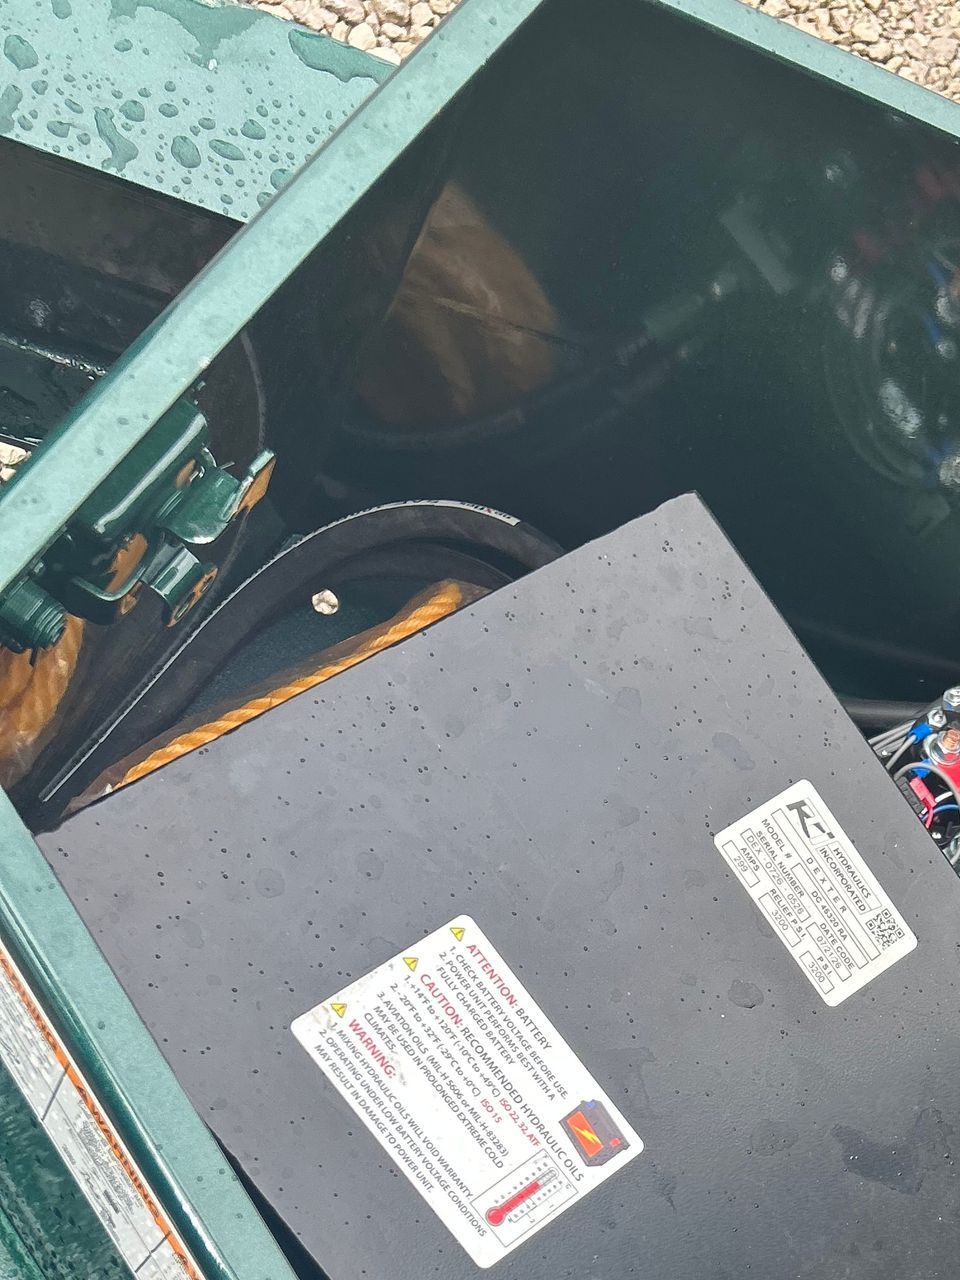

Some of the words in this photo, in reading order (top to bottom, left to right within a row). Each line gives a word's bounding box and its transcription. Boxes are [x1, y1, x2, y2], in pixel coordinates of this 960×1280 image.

[740, 846, 760, 871] AMPS
[746, 835, 763, 855] DEX
[755, 830, 779, 861] SERIAL
[776, 861, 804, 898] NUMBER
[760, 818, 786, 851] MODEL
[832, 847, 871, 899] HYDRAULICS
[769, 888, 792, 917] RELIEF
[770, 908, 789, 931] 3200
[818, 847, 866, 912] INCORPORATED
[807, 961, 825, 983] 3200
[819, 922, 837, 945] DATE
[835, 945, 854, 970] CODE
[836, 927, 848, 941] RA
[435, 966, 459, 992] FULLY
[454, 991, 489, 1032] CHARGED
[484, 1030, 515, 1066] BATTERY
[444, 959, 471, 990] POWER
[467, 989, 487, 1011] UNIT
[482, 1009, 520, 1053] PERFORMS
[515, 1051, 535, 1073] BEST
[530, 1070, 551, 1094] WITH
[547, 1092, 556, 1101] A
[454, 953, 479, 982] CHECK
[475, 980, 506, 1017] BATTERY
[501, 1014, 532, 1051] VOLTAGE
[528, 1050, 556, 1081] BEFORE
[551, 1080, 569, 1100] USE.
[464, 942, 520, 1008] ATTENTION:
[514, 1007, 552, 1051] BATTERY
[346, 1018, 398, 1079] WARNING:
[372, 1005, 391, 1025] MAY
[386, 1023, 399, 1035] BE
[395, 1034, 416, 1057] USED
[411, 1055, 423, 1066] IN
[418, 1064, 460, 1114] PROLONGED
[456, 1111, 487, 1148] EXTREME
[482, 1145, 504, 1169] COLD
[382, 998, 415, 1036] AVIATION
[410, 1034, 429, 1054] OILS
[445, 1079, 464, 1100] 5606
[460, 1098, 470, 1109] or
[412, 1011, 423, 1023] to
[454, 1066, 464, 1076] to
[479, 1098, 495, 1114] ISO
[490, 1112, 502, 1123] 15
[418, 972, 466, 1028] CAUTION:
[459, 1026, 524, 1105] RECOMMENDED
[519, 1103, 567, 1160] HYDRAULIC
[562, 1157, 584, 1182] OILS
[425, 1004, 436, 1015] to
[470, 1062, 481, 1073] to
[498, 1097, 513, 1112] ISO
[525, 1131, 541, 1148] ATF
[313, 1043, 332, 1063] MAY
[328, 1061, 354, 1091] RESULT
[350, 1089, 361, 1100] IN
[357, 1098, 388, 1134] DAMAGE
[383, 1131, 397, 1145] TO
[392, 1143, 419, 1173] POWER
[414, 1170, 435, 1193] UNIT.
[324, 1036, 363, 1081] OPERATING
[358, 1079, 384, 1108] UNDER
[380, 1106, 399, 1126] LOW
[394, 1124, 424, 1159] BATTERY
[420, 1156, 451, 1191] VOLTAGE
[446, 1189, 487, 1237] CONDITIONS
[335, 1029, 363, 1059] MIXING
[358, 1057, 397, 1103] HYDRAULIC
[392, 1100, 410, 1120] OILS
[406, 1117, 425, 1139] WILL
[420, 1136, 440, 1158] VOID
[436, 1155, 474, 1200] WARRANTY.
